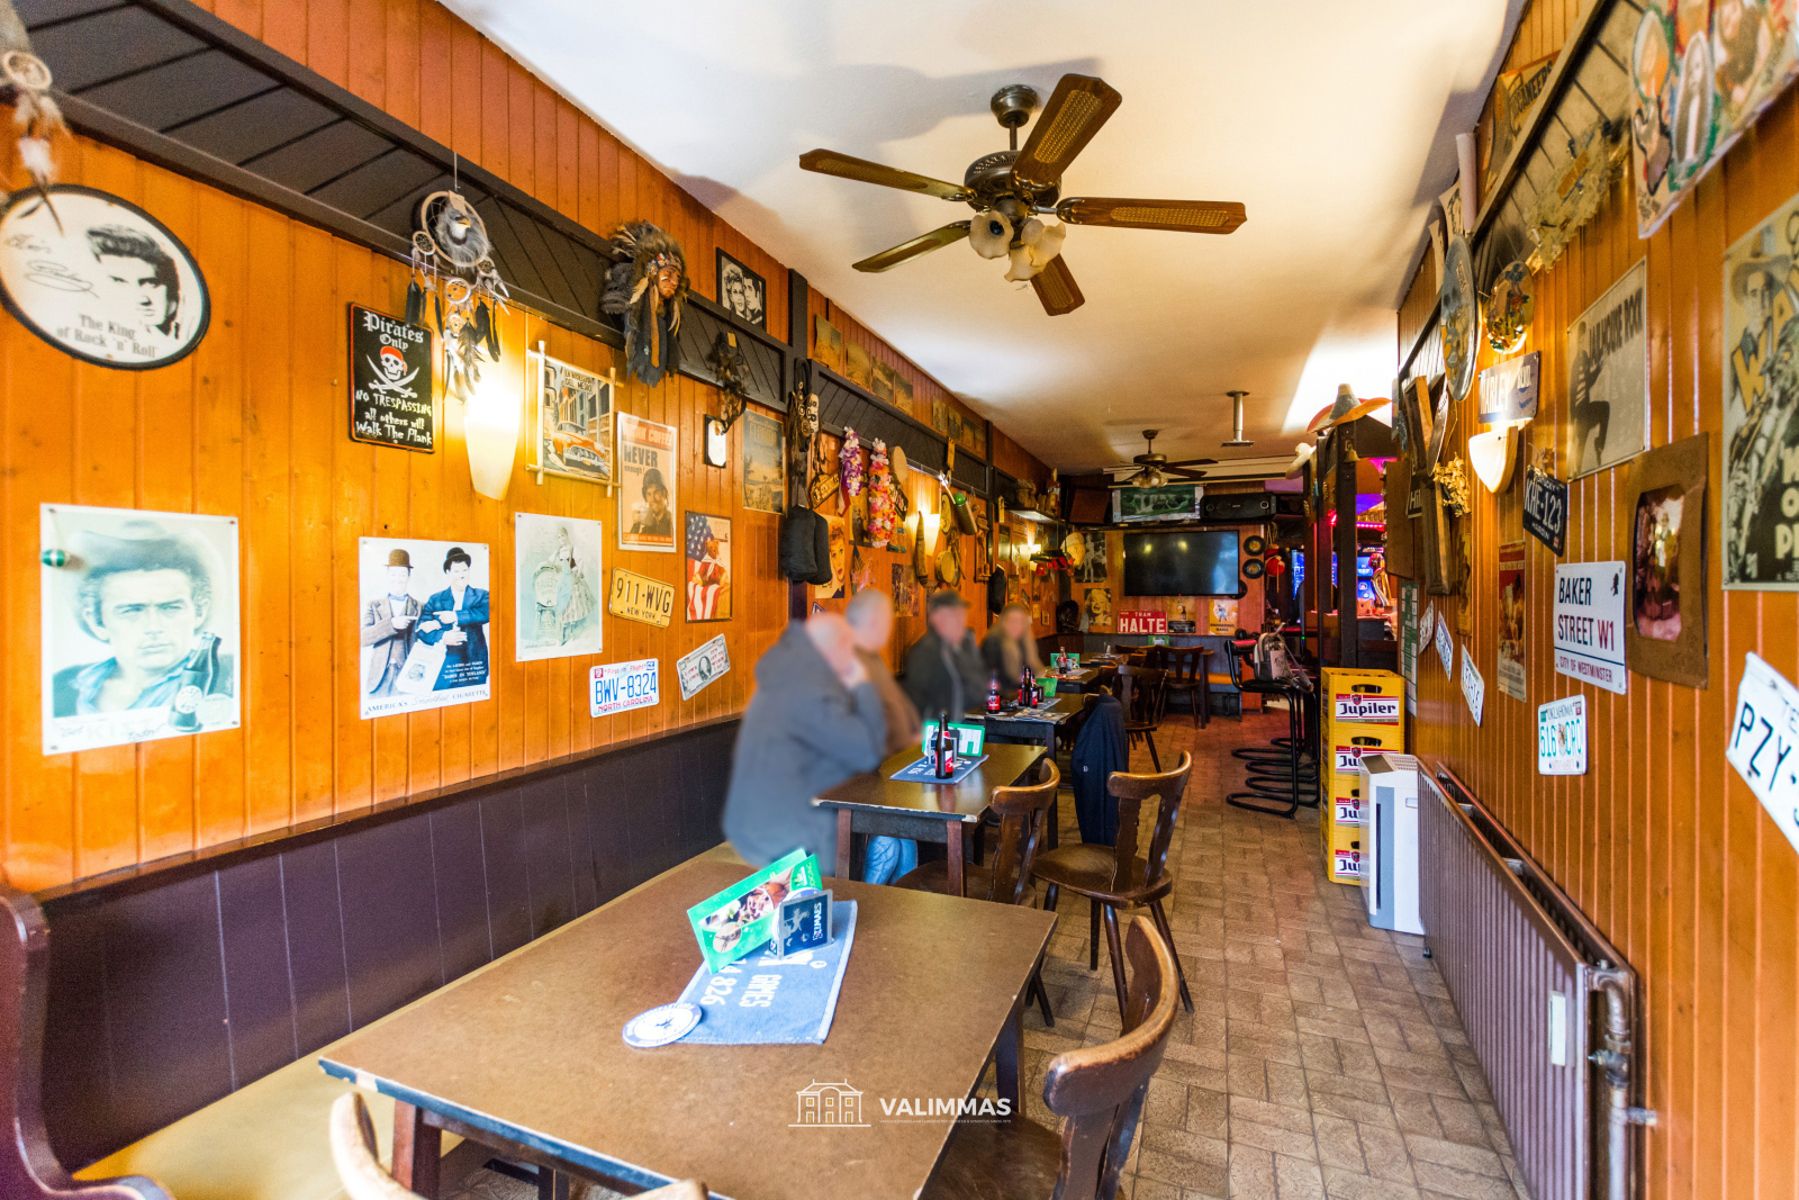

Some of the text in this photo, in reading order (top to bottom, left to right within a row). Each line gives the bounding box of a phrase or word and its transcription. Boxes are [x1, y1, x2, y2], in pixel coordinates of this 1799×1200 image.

[80, 314, 135, 340] The King
[363, 311, 424, 344] Pirates
[57, 326, 70, 338] of
[75, 329, 107, 348] Rock
[132, 342, 156, 358] Roll
[380, 333, 408, 353] Only
[356, 389, 432, 416] NO TRESPASSING
[364, 408, 425, 430] all others will
[356, 421, 432, 446] Walk The Plank
[1525, 480, 1561, 535] KHE-123
[1559, 577, 1592, 606] BAKER
[627, 607, 656, 619] NEW YORK
[1120, 618, 1165, 633] HALTE
[1558, 614, 1614, 651] STREET W1
[1560, 656, 1613, 683] CITY OF WESTMINSTER
[595, 672, 656, 704] BWV-8324
[598, 696, 653, 712] NORTH CAROLINA
[1340, 702, 1396, 716] Jupiler
